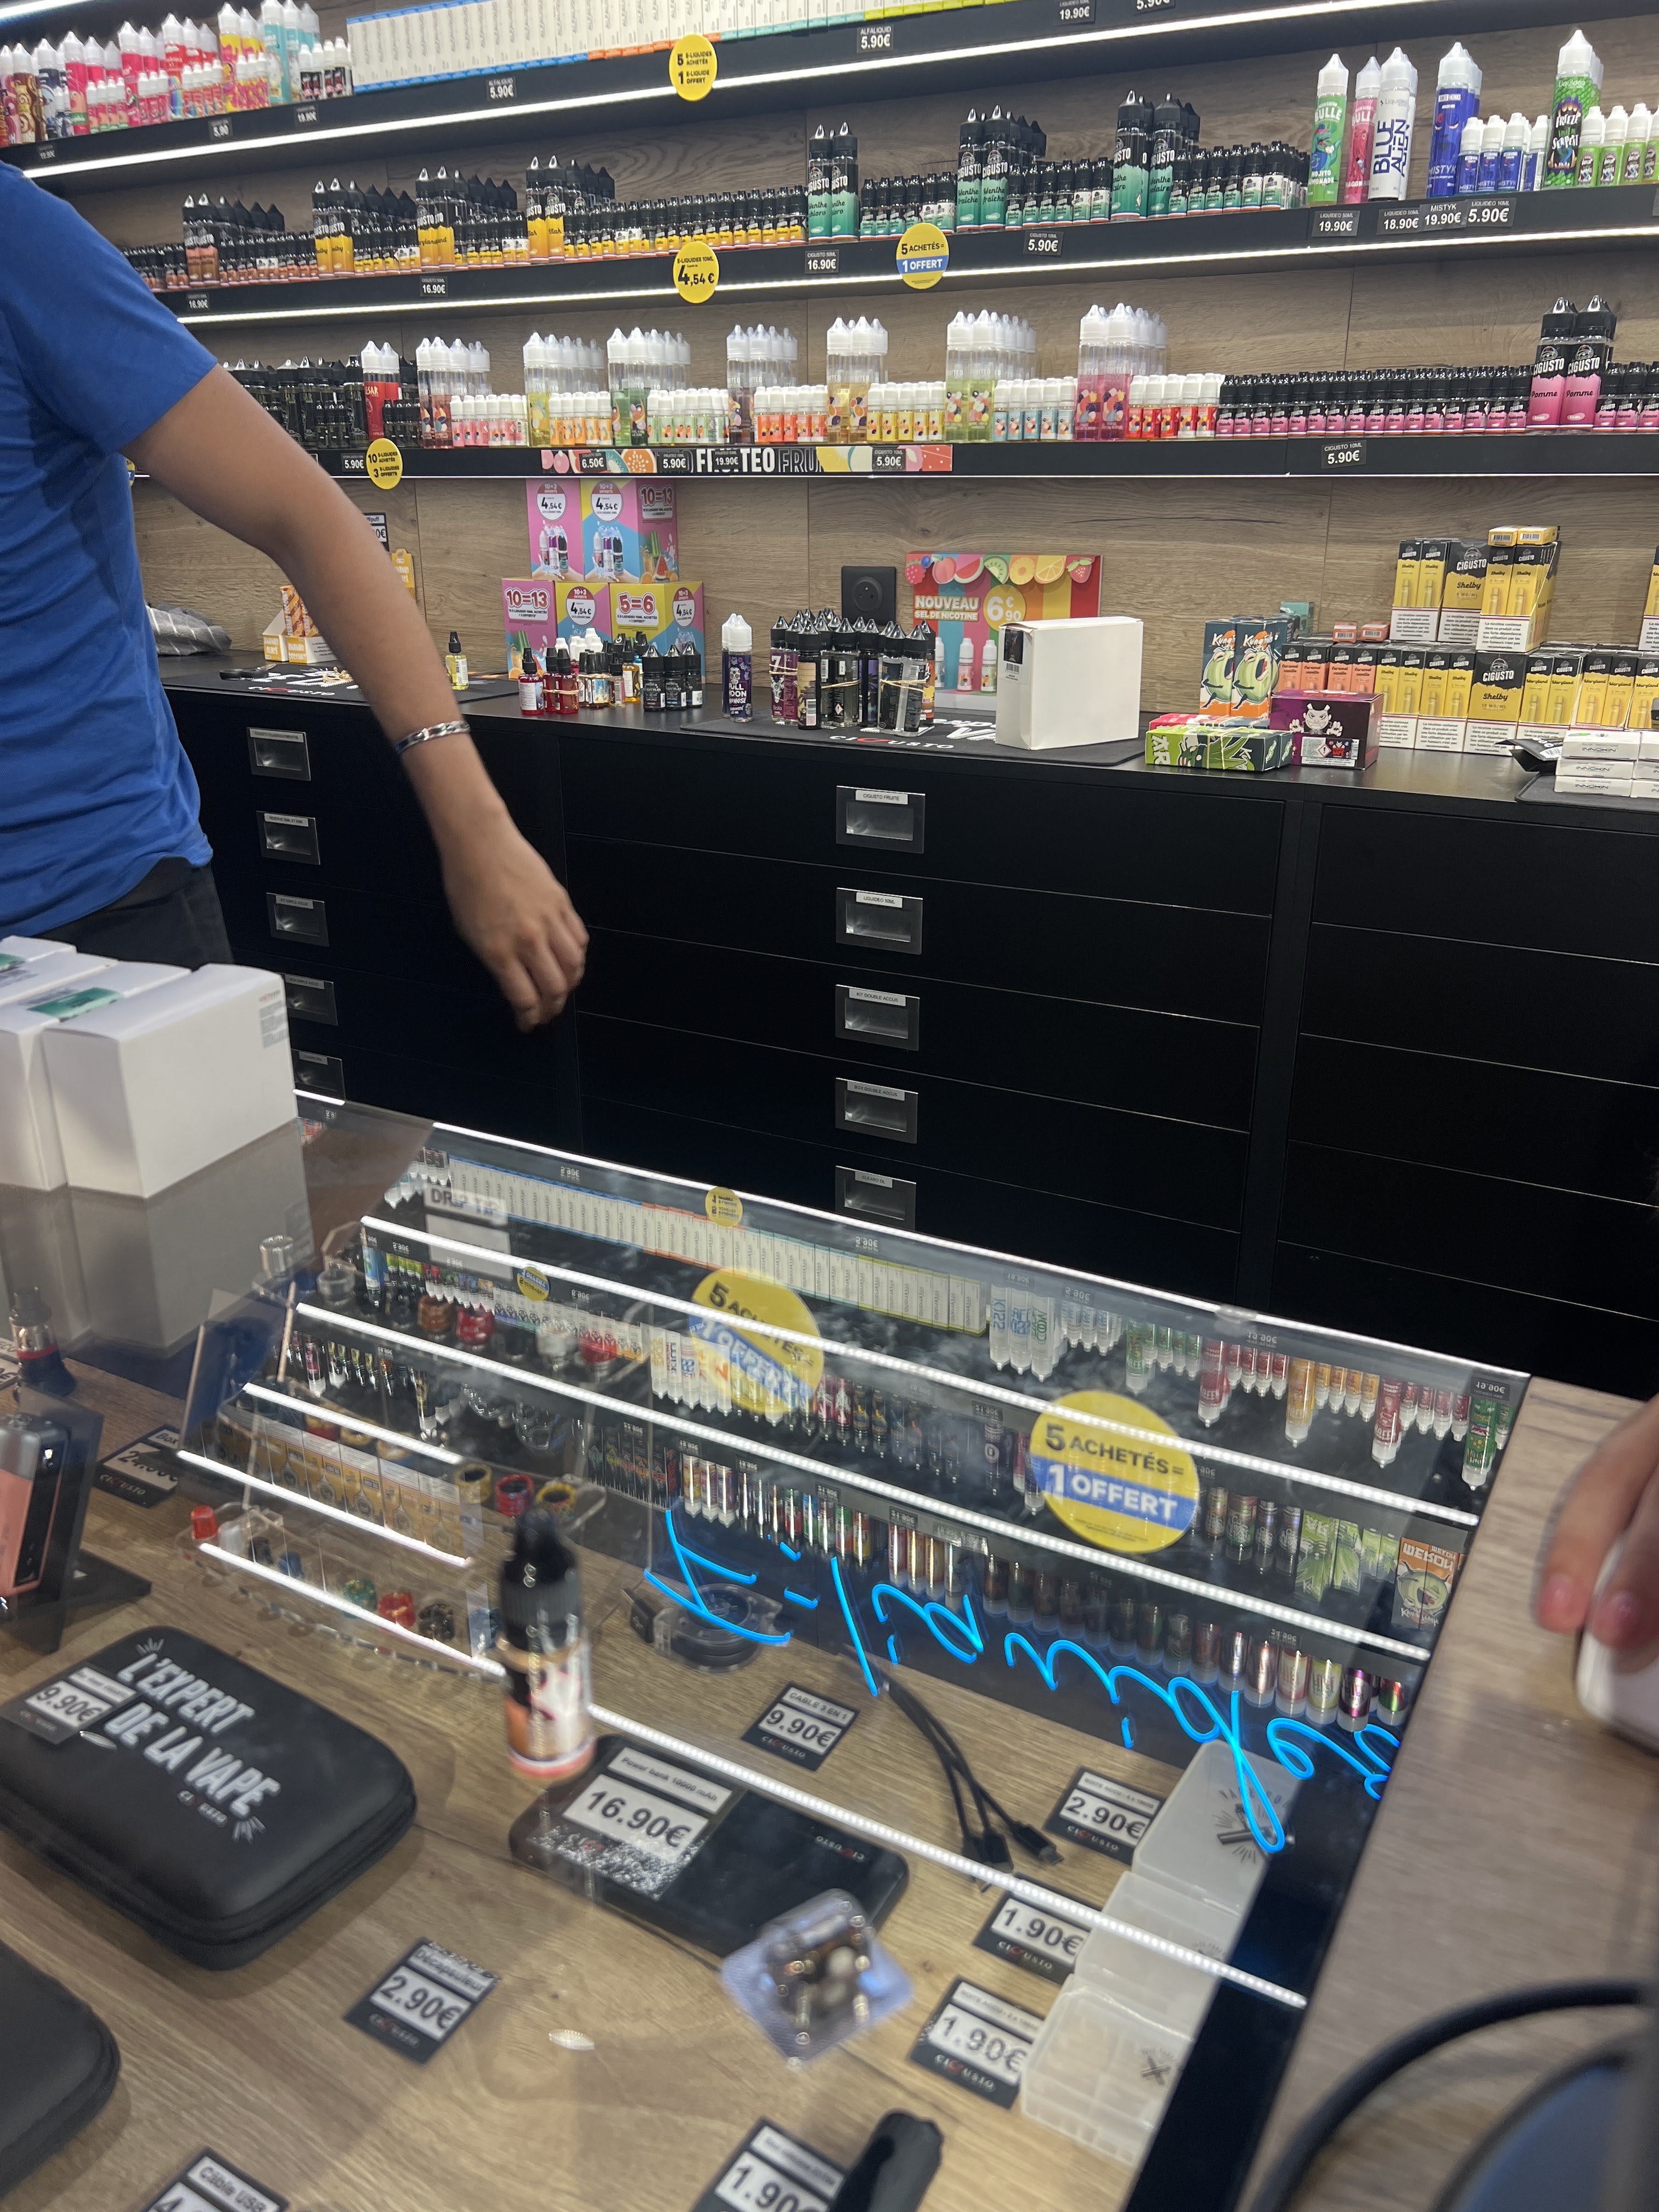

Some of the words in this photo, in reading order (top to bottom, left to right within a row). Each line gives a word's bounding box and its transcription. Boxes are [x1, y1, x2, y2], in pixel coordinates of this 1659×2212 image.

[1059, 6, 1090, 20] 19.90€
[860, 26, 891, 35] ALFALIQUID
[860, 33, 891, 49] 5.90€
[678, 53, 684, 66] 5
[678, 71, 684, 85] 1
[489, 83, 514, 99] 5.90€
[1314, 108, 1342, 122] BULLE
[1373, 119, 1395, 175] BLUE
[1430, 203, 1457, 213] MISTYK
[1467, 207, 1510, 223] 5.90€
[1318, 220, 1353, 232] 19.90€
[1384, 217, 1419, 230] 18.90€
[1424, 212, 1462, 226] 19.90€
[901, 243, 907, 255] 5
[909, 241, 940, 252] ACHETÉS
[1028, 238, 1059, 252] 5.90€
[808, 258, 837, 270] 16.90€
[902, 259, 909, 273] 1
[910, 258, 943, 270] OFFERT
[678, 264, 706, 287] 4,54
[707, 272, 715, 284] €
[422, 284, 446, 295] 16.90€
[1567, 356, 1600, 374] CIGUSTO
[1566, 390, 1594, 398] Pomme
[345, 459, 364, 469] 5.90€
[368, 454, 377, 464] 10
[582, 456, 605, 469] 6.50€
[662, 458, 686, 469] 5.90€
[714, 456, 739, 466] 19.90€
[876, 456, 902, 467] 5.90€
[1327, 450, 1360, 465] 5.90€
[373, 469, 379, 478] 3
[541, 496, 557, 510] 4,54
[596, 497, 613, 511] 4,54
[1457, 558, 1487, 571] CIGUSTO
[1456, 582, 1481, 590] Shelby
[506, 589, 549, 608] 10=13
[618, 593, 656, 614] 5=6
[915, 595, 979, 611] NOUVEAU
[570, 602, 587, 616] 4,54
[940, 612, 978, 620] NICOTINE
[988, 596, 1005, 622] 6
[1006, 596, 1015, 608] €
[1005, 610, 1022, 622] 90
[1482, 670, 1514, 682] CIGUSTO
[1482, 693, 1509, 702] Shelby
[829, 735, 954, 749] CIGUSTO
[709, 1279, 730, 1308] 5
[1045, 1422, 1067, 1453] 5
[1069, 1432, 1169, 1476] ACHETÉS
[1047, 1464, 1066, 1500] 1
[1070, 1475, 1178, 1520] OFFERT
[116, 1653, 256, 1734] L'EXPERT
[789, 1691, 818, 1709] CABLE
[827, 1706, 840, 1717] EN
[766, 1709, 836, 1748] 9.90€
[104, 1701, 170, 1746] DE
[144, 1725, 205, 1771] LA
[184, 1747, 282, 1818] VAPE
[586, 1790, 692, 1848] 16.90€
[1064, 1795, 1148, 1841] 2.90€
[1002, 1908, 1084, 1957] 1.90€
[379, 1974, 462, 2030] 2.90€
[940, 2011, 1028, 2073] 1.90€
